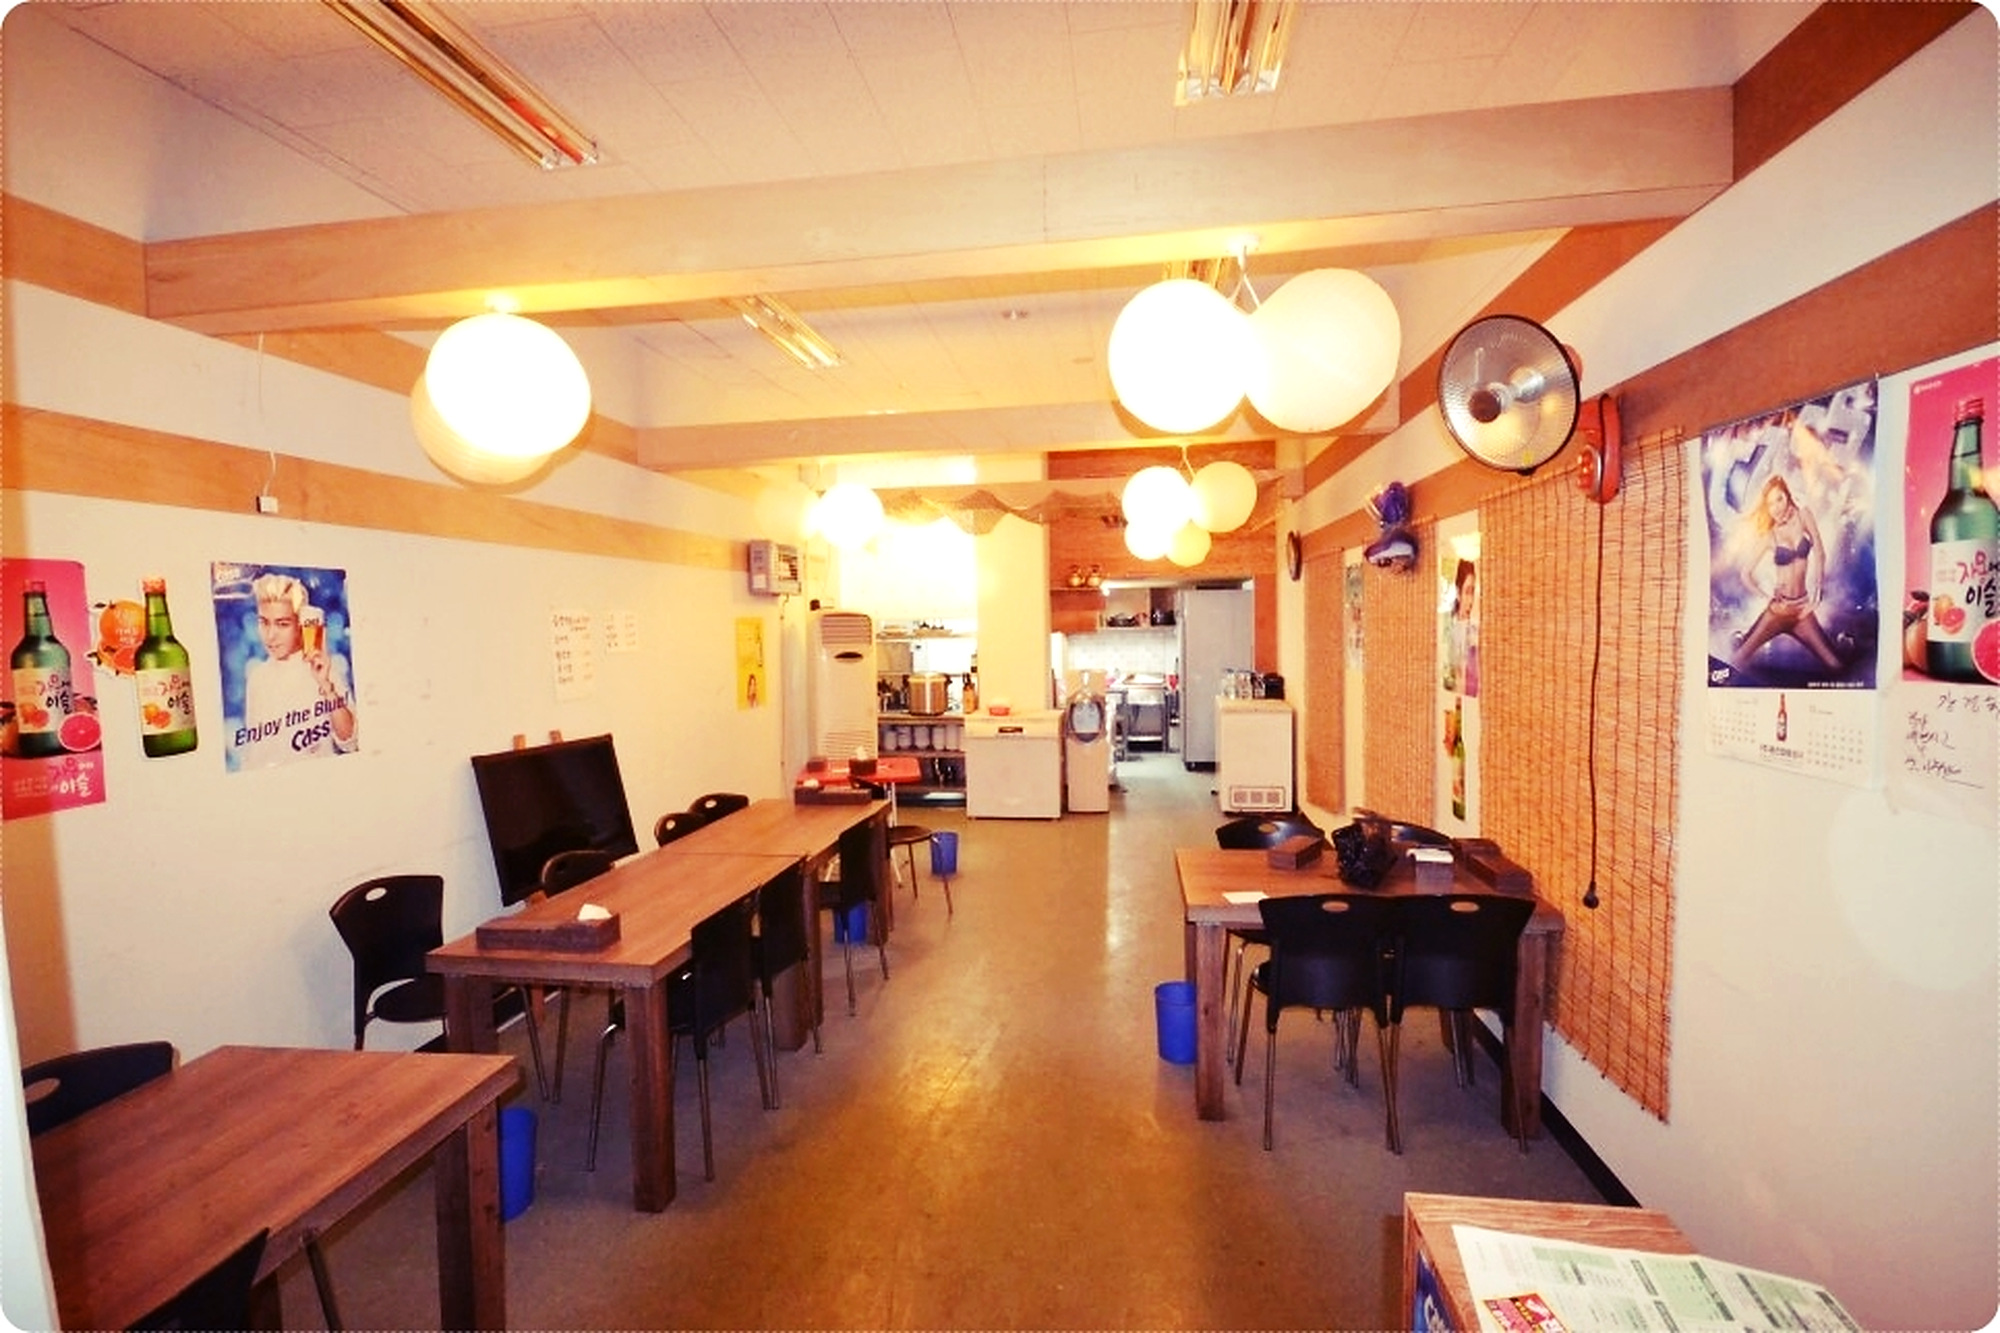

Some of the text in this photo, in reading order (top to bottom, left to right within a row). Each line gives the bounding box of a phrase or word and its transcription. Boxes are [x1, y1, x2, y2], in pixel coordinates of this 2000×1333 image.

[1966, 577, 1998, 618] 이슬
[235, 691, 348, 747] Enjoy the Blue!
